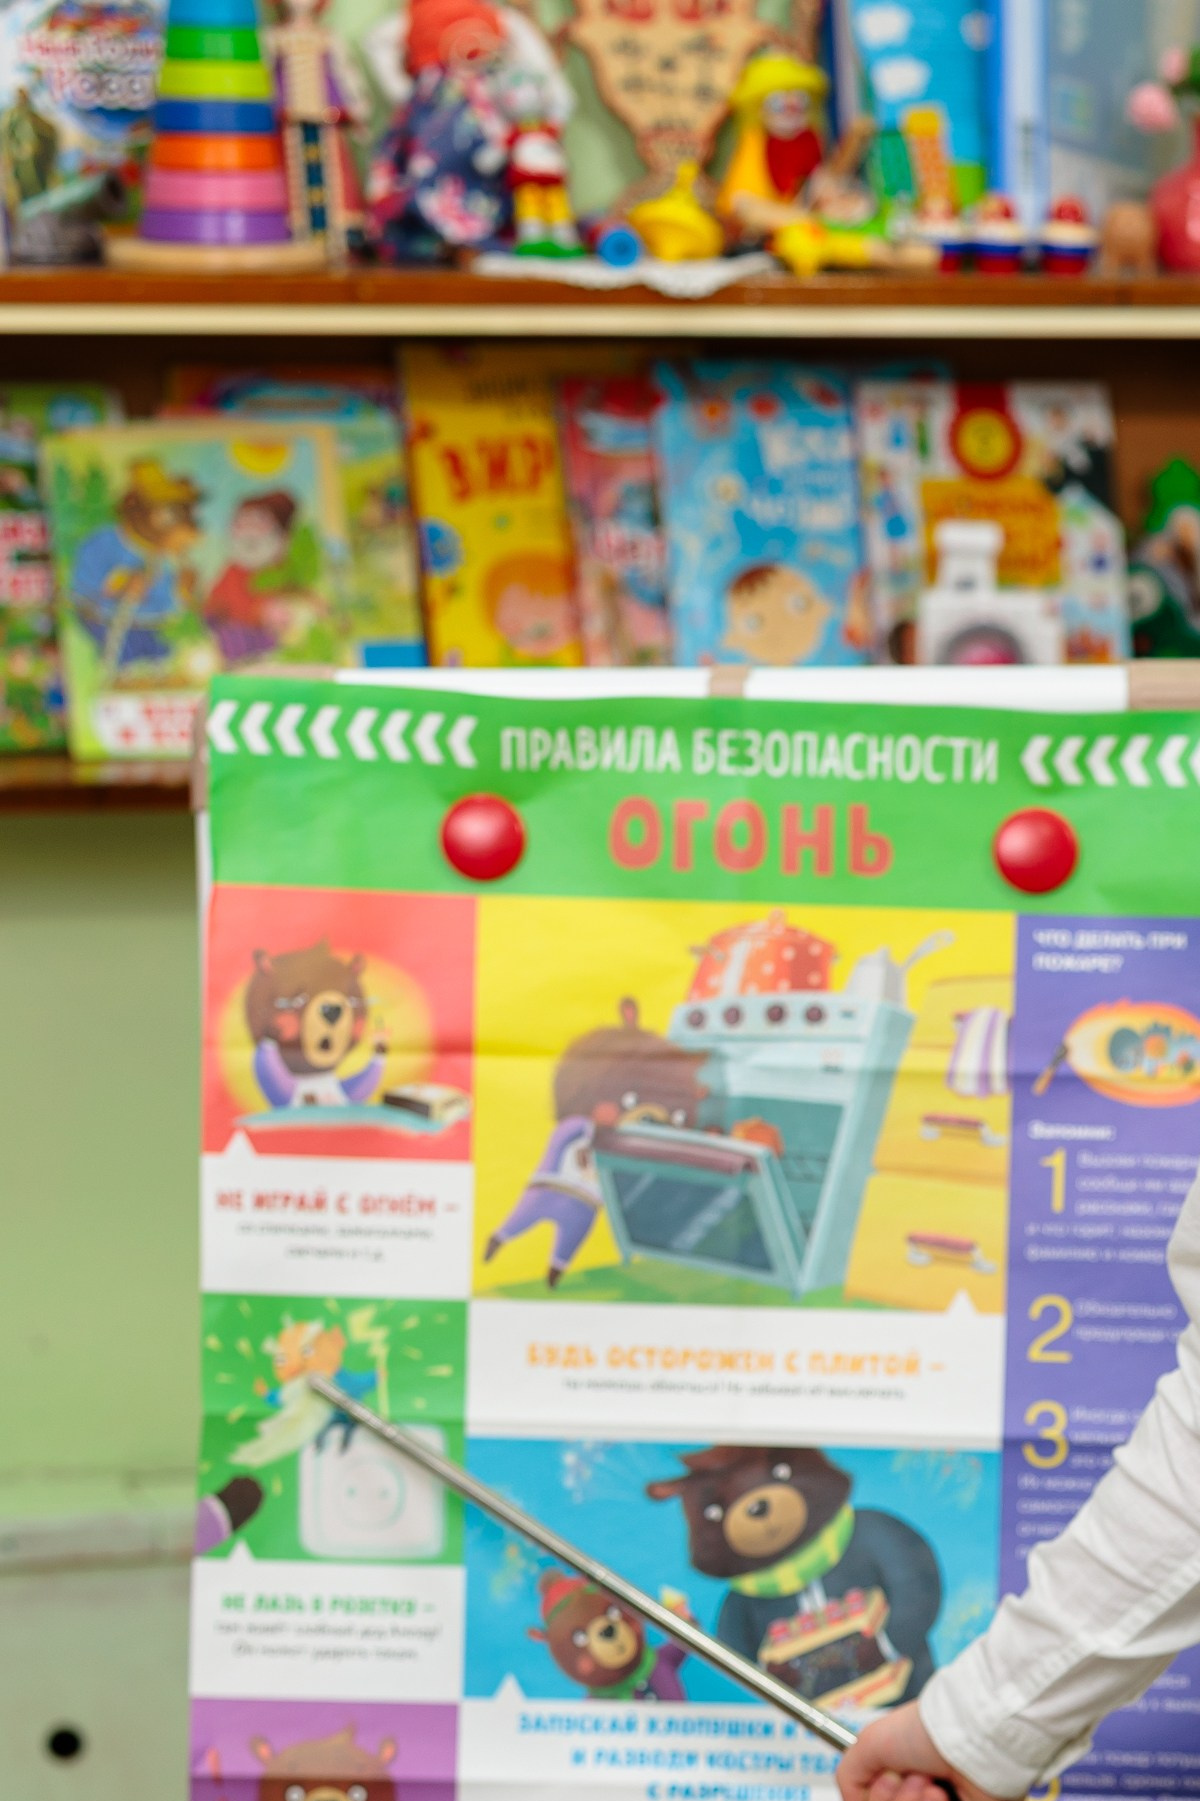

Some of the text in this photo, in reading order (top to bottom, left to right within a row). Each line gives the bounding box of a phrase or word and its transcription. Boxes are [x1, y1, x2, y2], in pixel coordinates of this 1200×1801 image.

[500, 726, 999, 784] ПРАВИЛА БЕЗОПАСНОСТИ
[608, 795, 894, 878] ОГОНЬ
[1032, 928, 1188, 951] ЧТО ДЕЛАТЬ ПРИ
[1032, 952, 1124, 973] ПОЖАРЕ?
[1040, 1147, 1067, 1213] 1
[215, 1189, 245, 1213] НЕ
[250, 1187, 329, 1213] ИГРАЙ
[334, 1192, 352, 1215] С
[1027, 1293, 1074, 1364] 2
[525, 1342, 598, 1371] БУДЬ
[605, 1344, 776, 1375] ОСТОРОЖЕН
[781, 1350, 803, 1375] С
[806, 1347, 925, 1378] ПЛИТОЙ
[1022, 1400, 1069, 1469] 3
[219, 1593, 247, 1613] НЕ
[251, 1593, 307, 1615] ЛАЗЬ
[328, 1595, 418, 1618] РОЗЕТКУ
[515, 1711, 798, 1741] ЗАПУСКАЙ ХЛОПУШКИ И
[569, 1747, 842, 1776] И РАЗВОДИ КОСТРЫ ТОЛ
[645, 1782, 662, 1801] С
